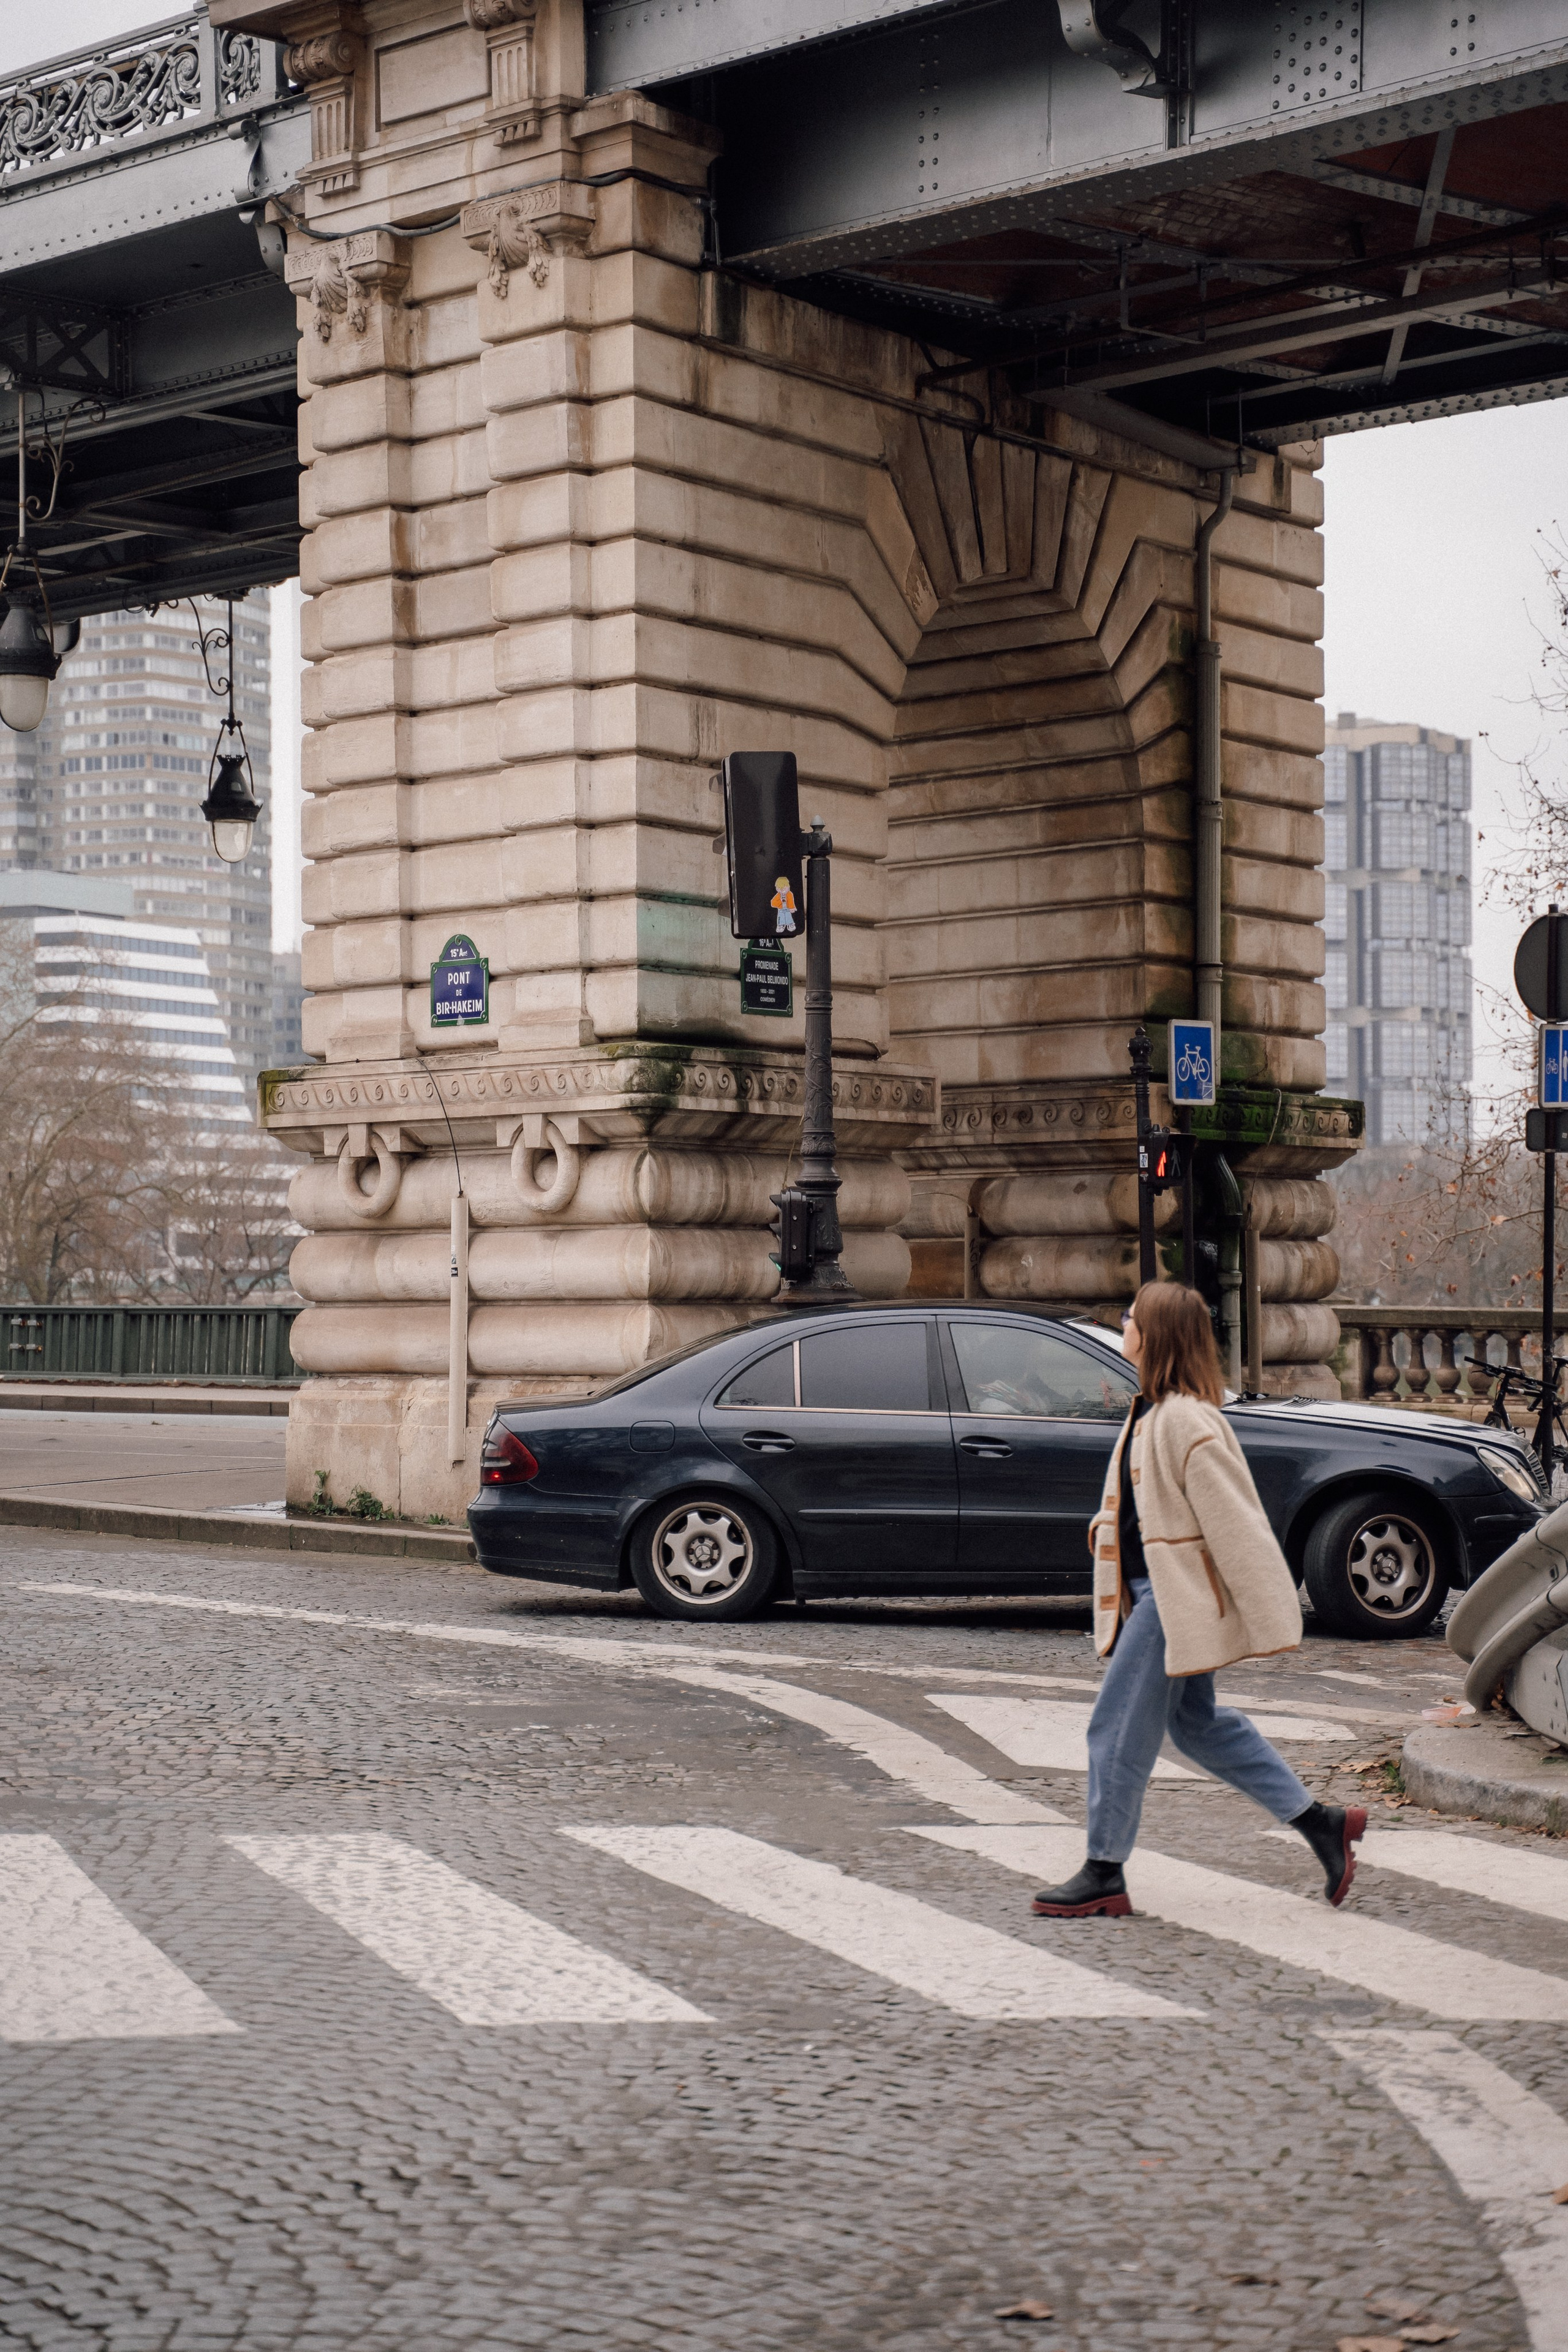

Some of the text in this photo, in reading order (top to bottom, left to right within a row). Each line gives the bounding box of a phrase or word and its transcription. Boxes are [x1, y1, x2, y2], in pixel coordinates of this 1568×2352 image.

[755, 960, 778, 970] PROMENADE
[448, 971, 470, 986] PONT
[745, 973, 788, 985] JEAN-PAUL BELMONDO
[436, 999, 483, 1015] BIR-HAKEIM
